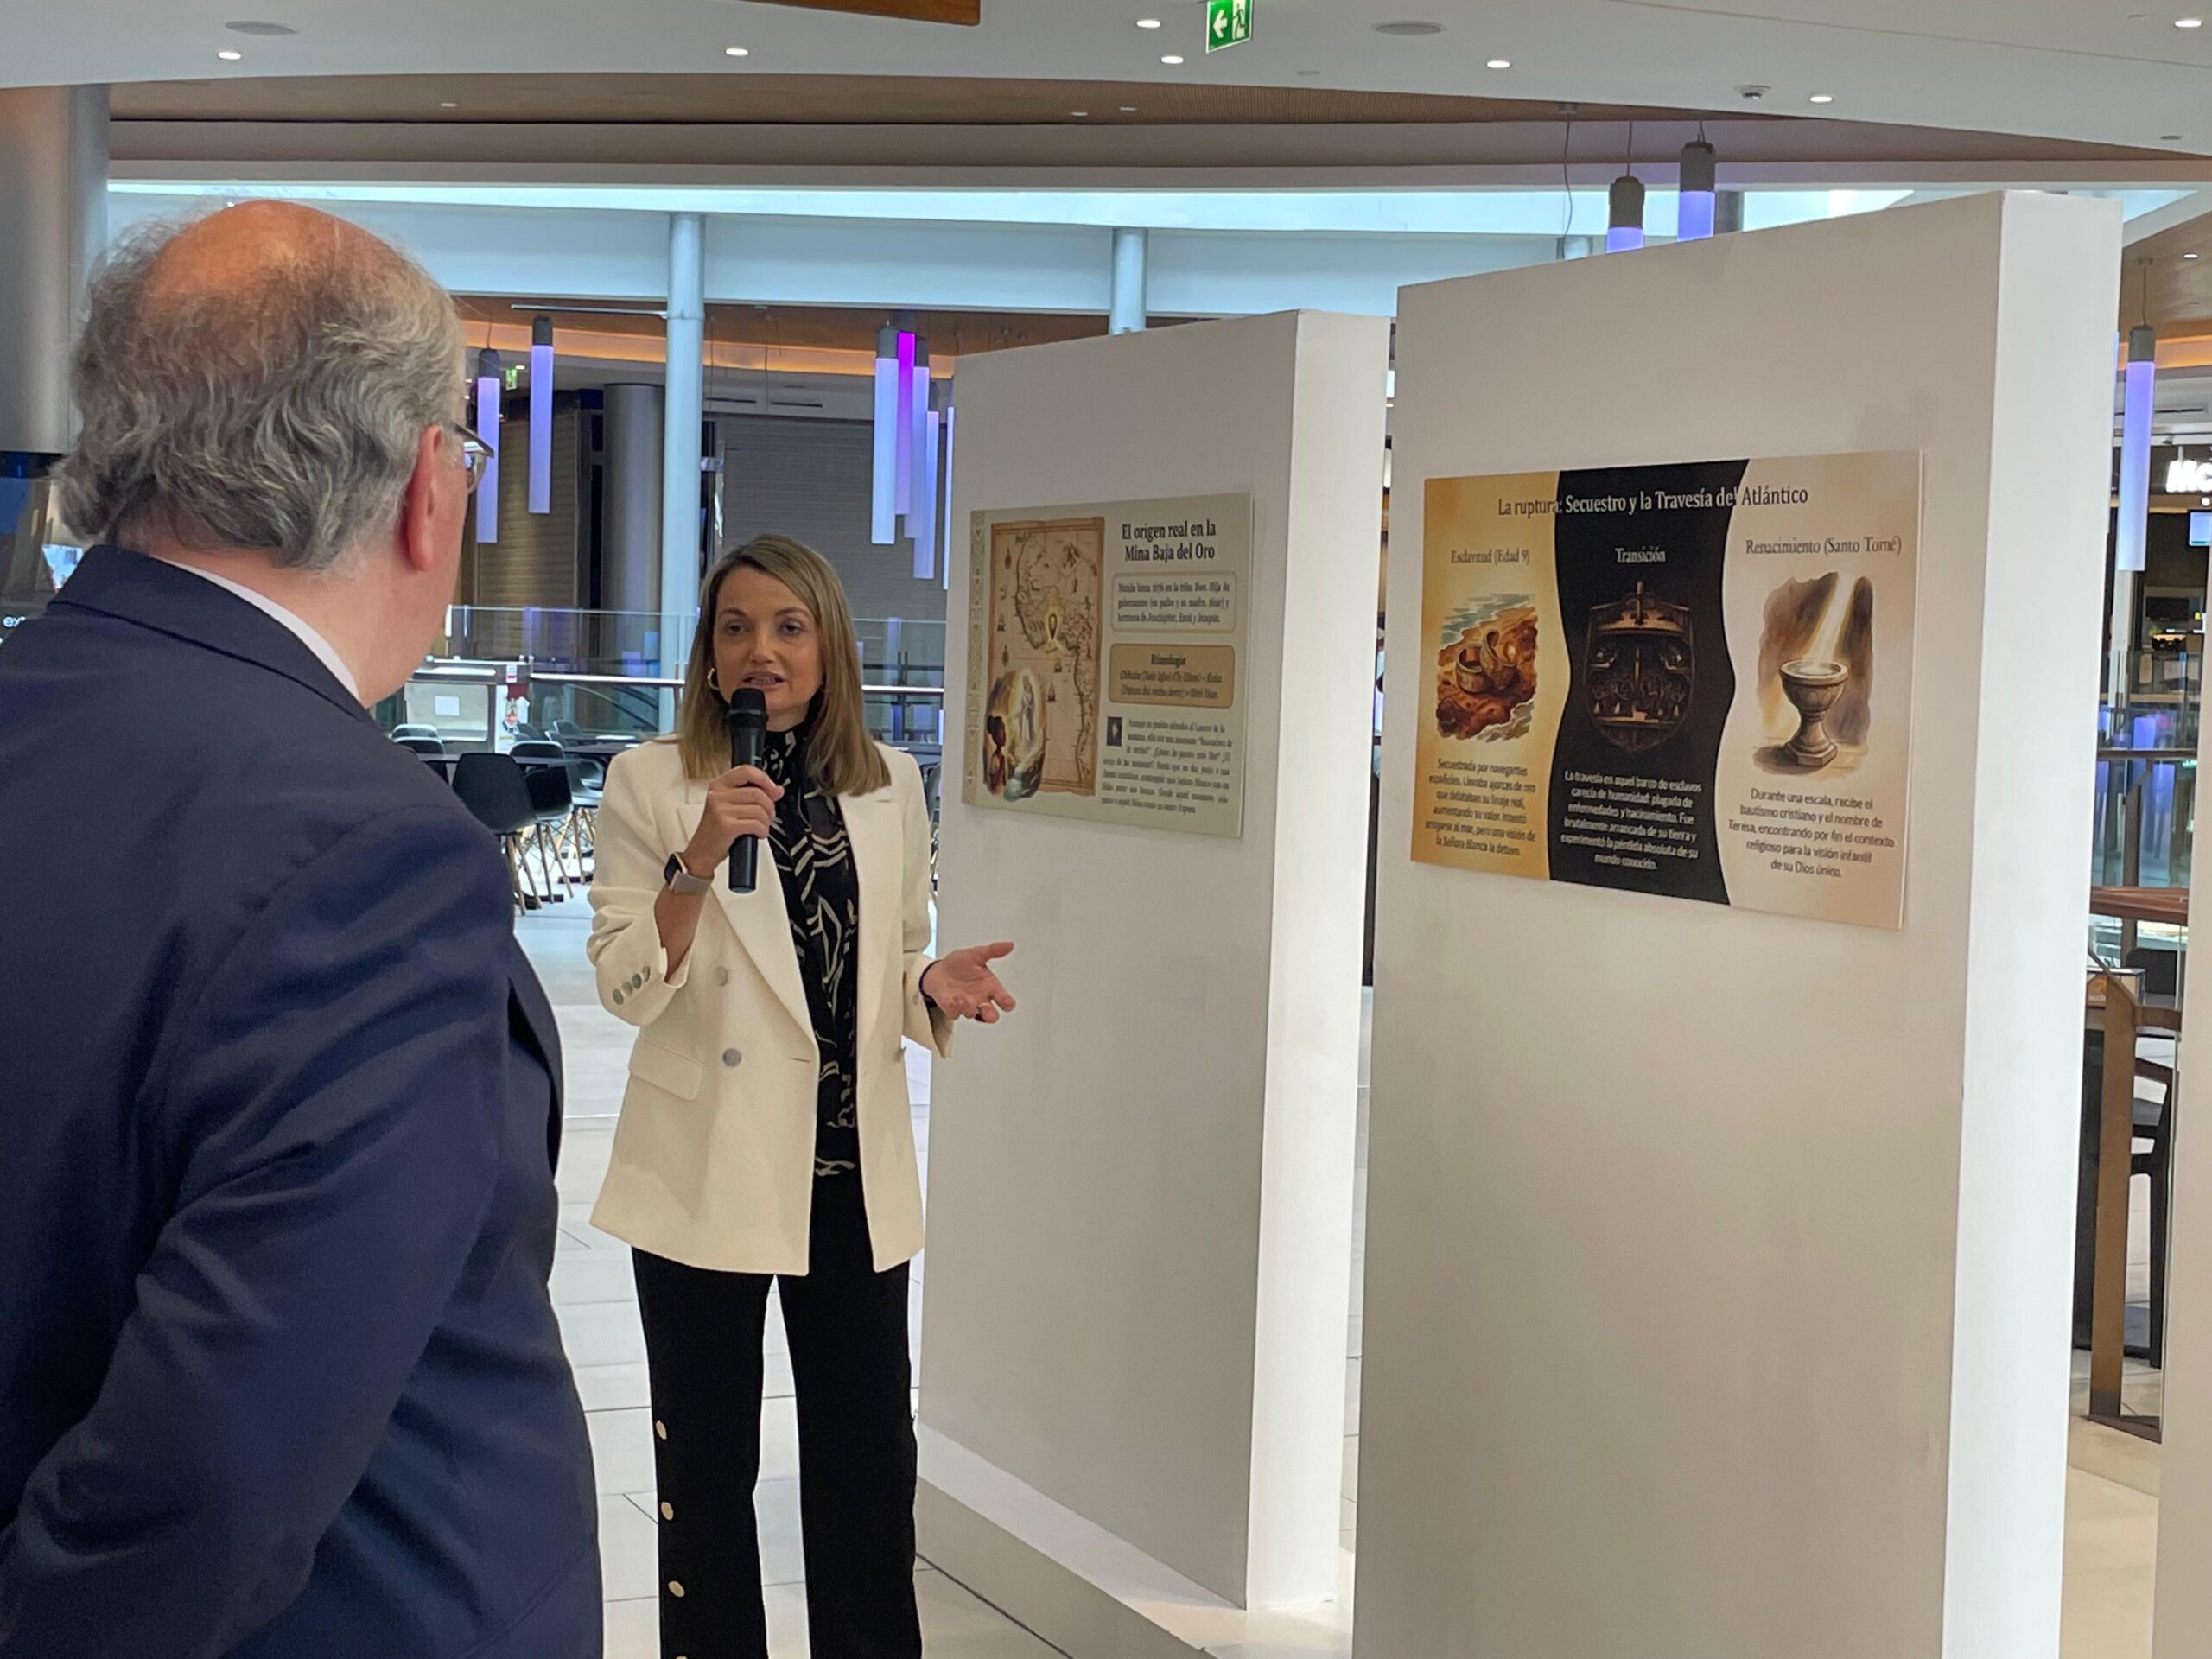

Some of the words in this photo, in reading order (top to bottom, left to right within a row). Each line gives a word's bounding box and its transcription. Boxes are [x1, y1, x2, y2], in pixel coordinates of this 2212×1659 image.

[1498, 499, 1511, 515] La
[1515, 499, 1562, 518] ruptura:
[1566, 494, 1625, 512] Secuestro
[1629, 496, 1637, 515] y
[1640, 491, 1651, 510] la
[1655, 488, 1713, 509] Travesía
[1716, 486, 1738, 506] del
[1742, 485, 1808, 505] Atlántico
[1122, 524, 1131, 539] El
[1134, 523, 1165, 543] origen
[1168, 520, 1187, 537] real
[1191, 524, 1203, 537] en
[1207, 519, 1216, 536] la
[1125, 545, 1149, 561] Mina
[1153, 543, 1174, 563] Baja
[1177, 543, 1192, 559] del
[1196, 543, 1215, 559] Oro
[1615, 546, 1665, 562] Transición
[1746, 537, 1821, 554] Renacimiento
[1824, 537, 1859, 556] (Santo
[1864, 535, 1901, 556] Tomé)
[1451, 550, 1491, 563] Esclavitud
[1494, 549, 1519, 565] (Edad
[1522, 550, 1530, 564] 9)
[1478, 764, 1488, 774] por
[1514, 781, 1522, 791] de
[1565, 771, 1573, 781] La
[1658, 778, 1669, 789] de
[1682, 796, 1693, 808] de
[1751, 788, 1785, 802] Durante
[1787, 792, 1802, 803] una
[1805, 794, 1833, 806] escala,
[1835, 797, 1862, 809] recibe
[1865, 798, 1872, 810] el
[1620, 808, 1625, 819] y
[1679, 811, 1694, 824] Fue
[1740, 804, 1777, 817] bautismo
[1780, 806, 1815, 820] cristiano
[1817, 813, 1823, 823] y
[1825, 813, 1834, 823] el
[1835, 815, 1870, 827] nombre
[1872, 816, 1883, 828] de
[1647, 826, 1657, 837] de
[1691, 832, 1697, 843] y
[1729, 819, 1756, 833] Teresa,
[1758, 824, 1812, 840] encontrando
[1815, 830, 1828, 841] por
[1831, 830, 1843, 841] fin
[1845, 831, 1853, 843] el
[1854, 834, 1894, 848] contexto
[1677, 845, 1688, 857] de
[1688, 849, 1699, 859] su
[1746, 839, 1781, 854] religioso
[1783, 844, 1802, 856] para
[1804, 845, 1811, 856] la
[1814, 848, 1839, 859] visión
[1840, 849, 1872, 863] infantil
[1771, 859, 1782, 869] de
[1783, 862, 1793, 872] su
[1796, 861, 1814, 874] Dios
